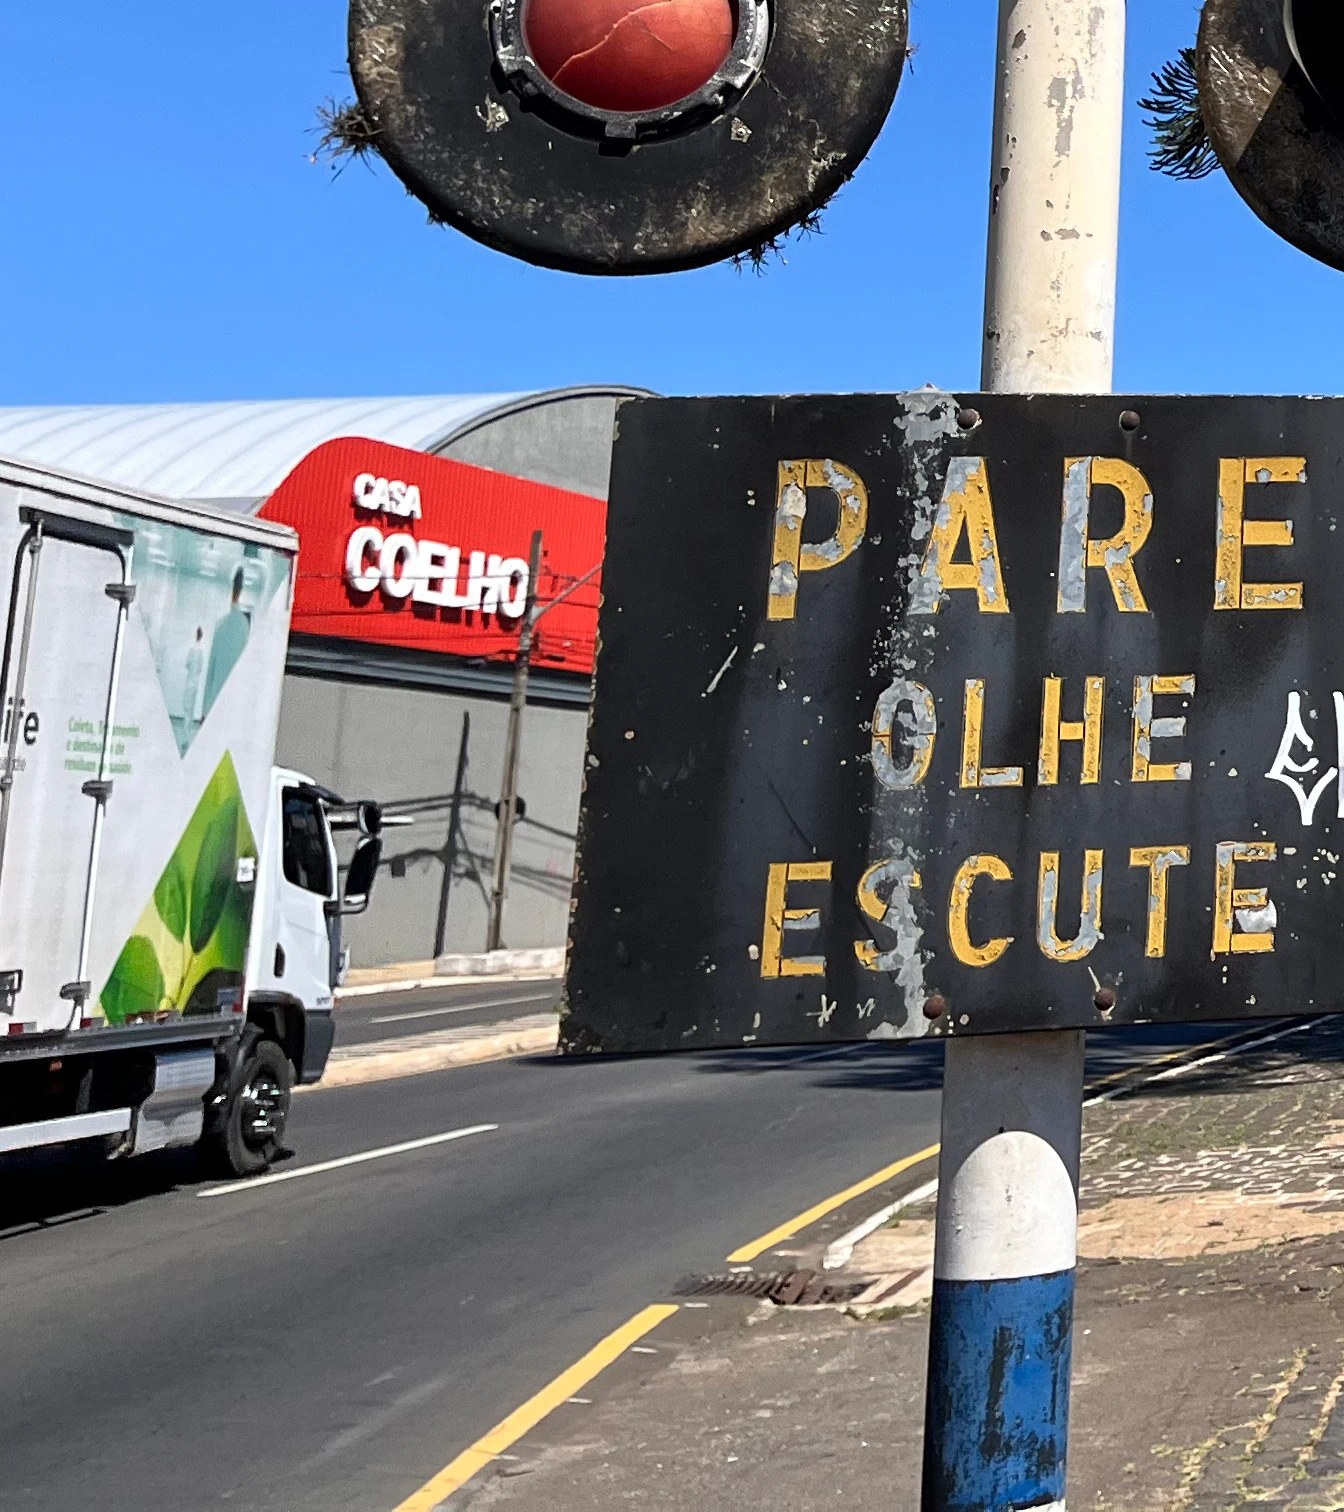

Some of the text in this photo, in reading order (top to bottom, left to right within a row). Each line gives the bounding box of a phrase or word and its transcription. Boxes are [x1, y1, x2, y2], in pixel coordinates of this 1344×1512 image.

[353, 472, 423, 520] CASA
[766, 455, 1307, 621] PARE
[345, 526, 530, 618] COELHO
[871, 674, 1196, 789] OLHE
[760, 841, 1279, 978] ESCUTE
